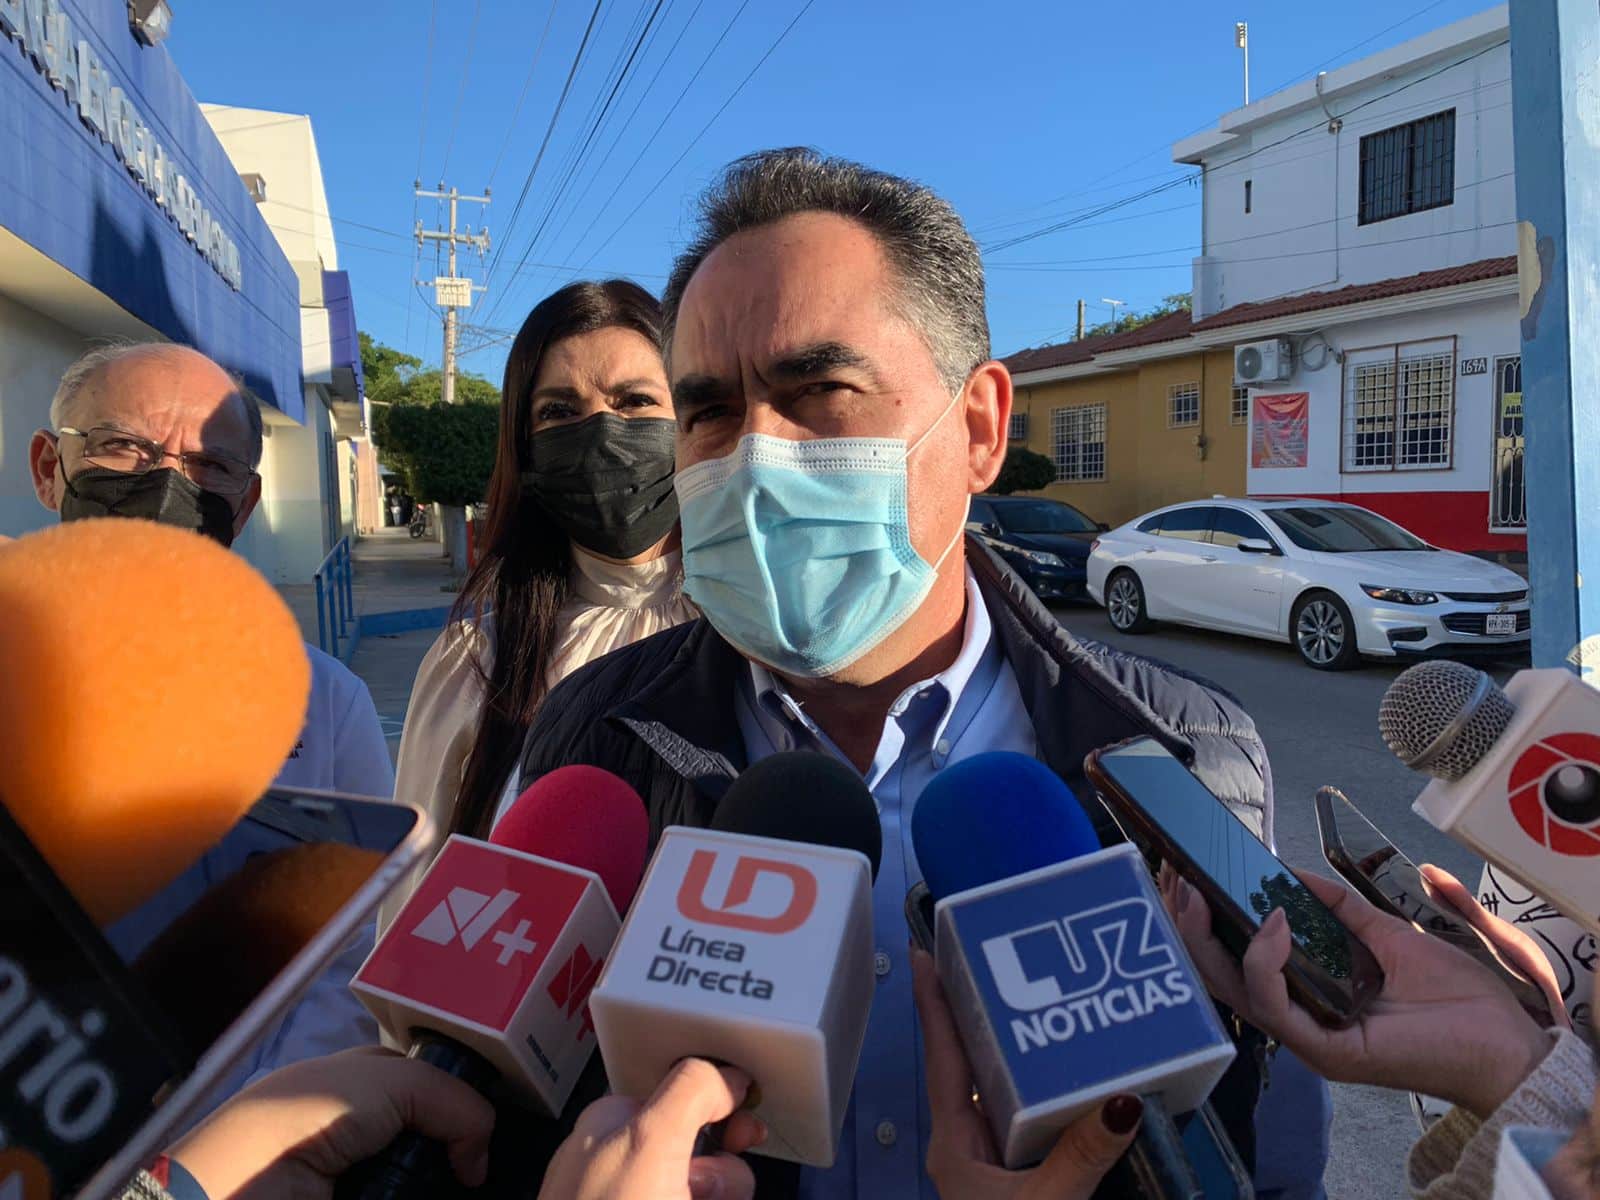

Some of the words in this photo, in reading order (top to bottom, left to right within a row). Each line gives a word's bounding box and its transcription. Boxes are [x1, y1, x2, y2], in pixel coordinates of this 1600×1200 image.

[659, 925, 746, 963] Línea
[647, 955, 774, 1000] Directa
[1010, 970, 1192, 1053] NOTICIAS
